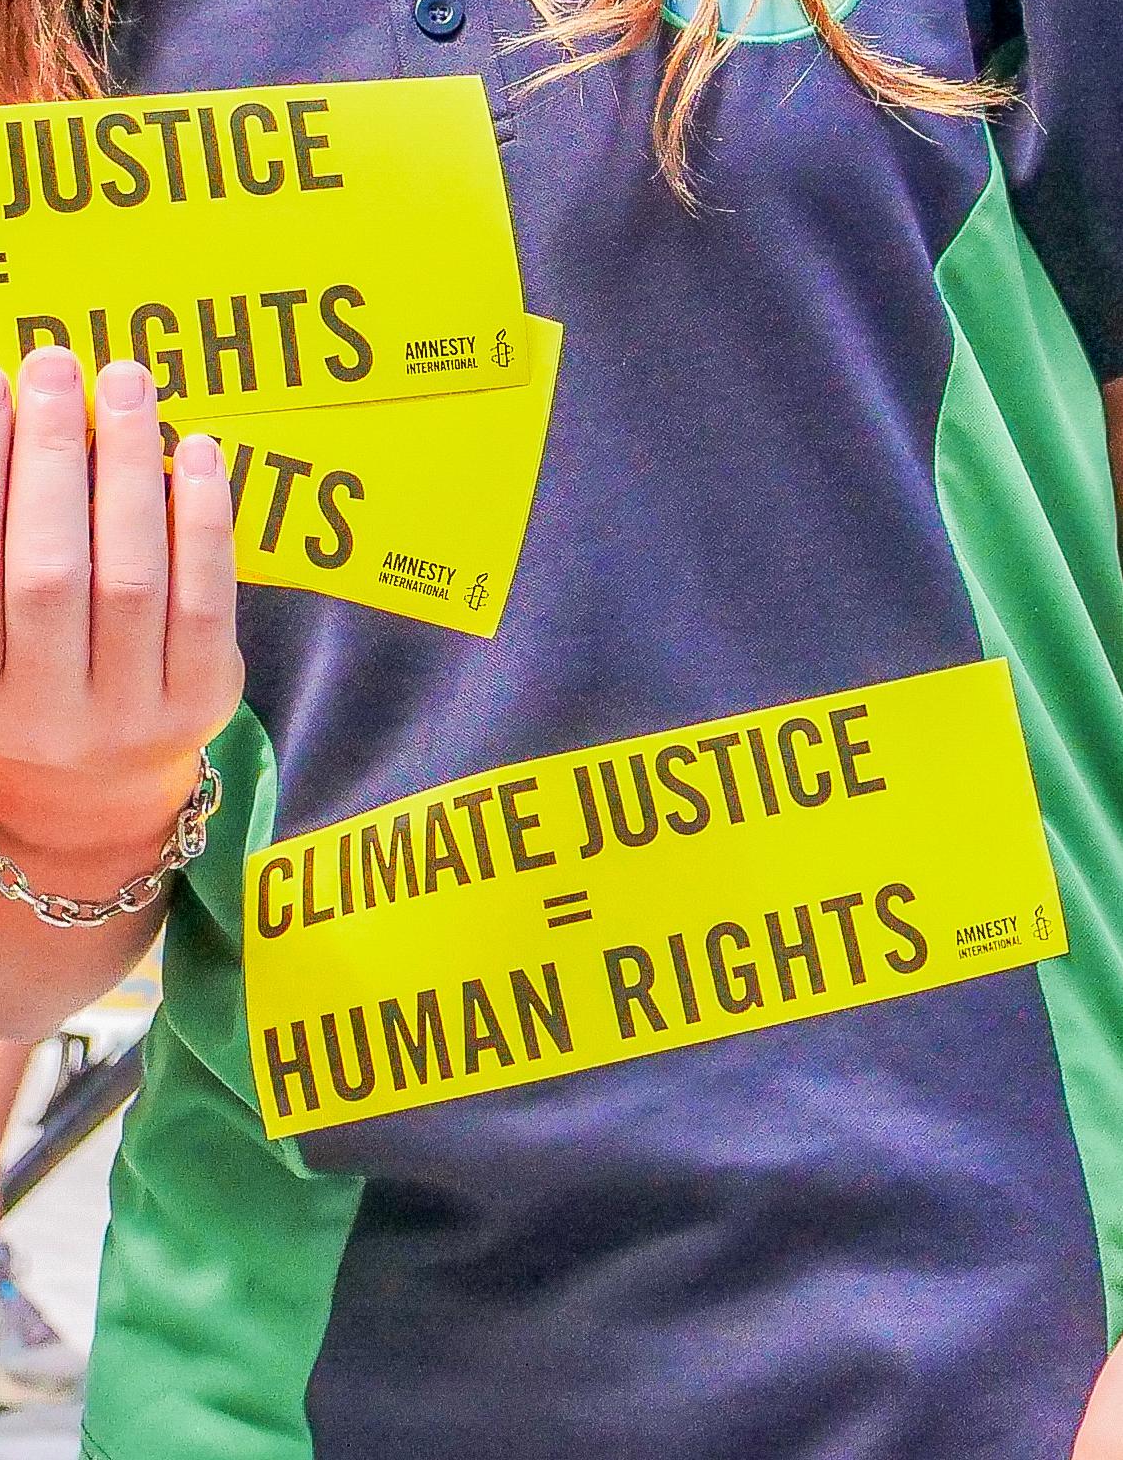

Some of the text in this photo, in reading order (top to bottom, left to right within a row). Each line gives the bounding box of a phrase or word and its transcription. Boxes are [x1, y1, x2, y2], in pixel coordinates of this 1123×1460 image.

[405, 336, 476, 361] AMNESTY
[406, 358, 479, 375] INTERNATIONAL
[382, 551, 457, 586] AMNESTY
[378, 571, 451, 601] INTERNATIONAL
[258, 704, 887, 939] CLIMATE JUSTICE
[542, 890, 594, 929] =
[956, 916, 1018, 946] AMNESTY
[958, 935, 1022, 959] INTERNATIONAL
[264, 882, 928, 1118] HUMAN RIGHTS
